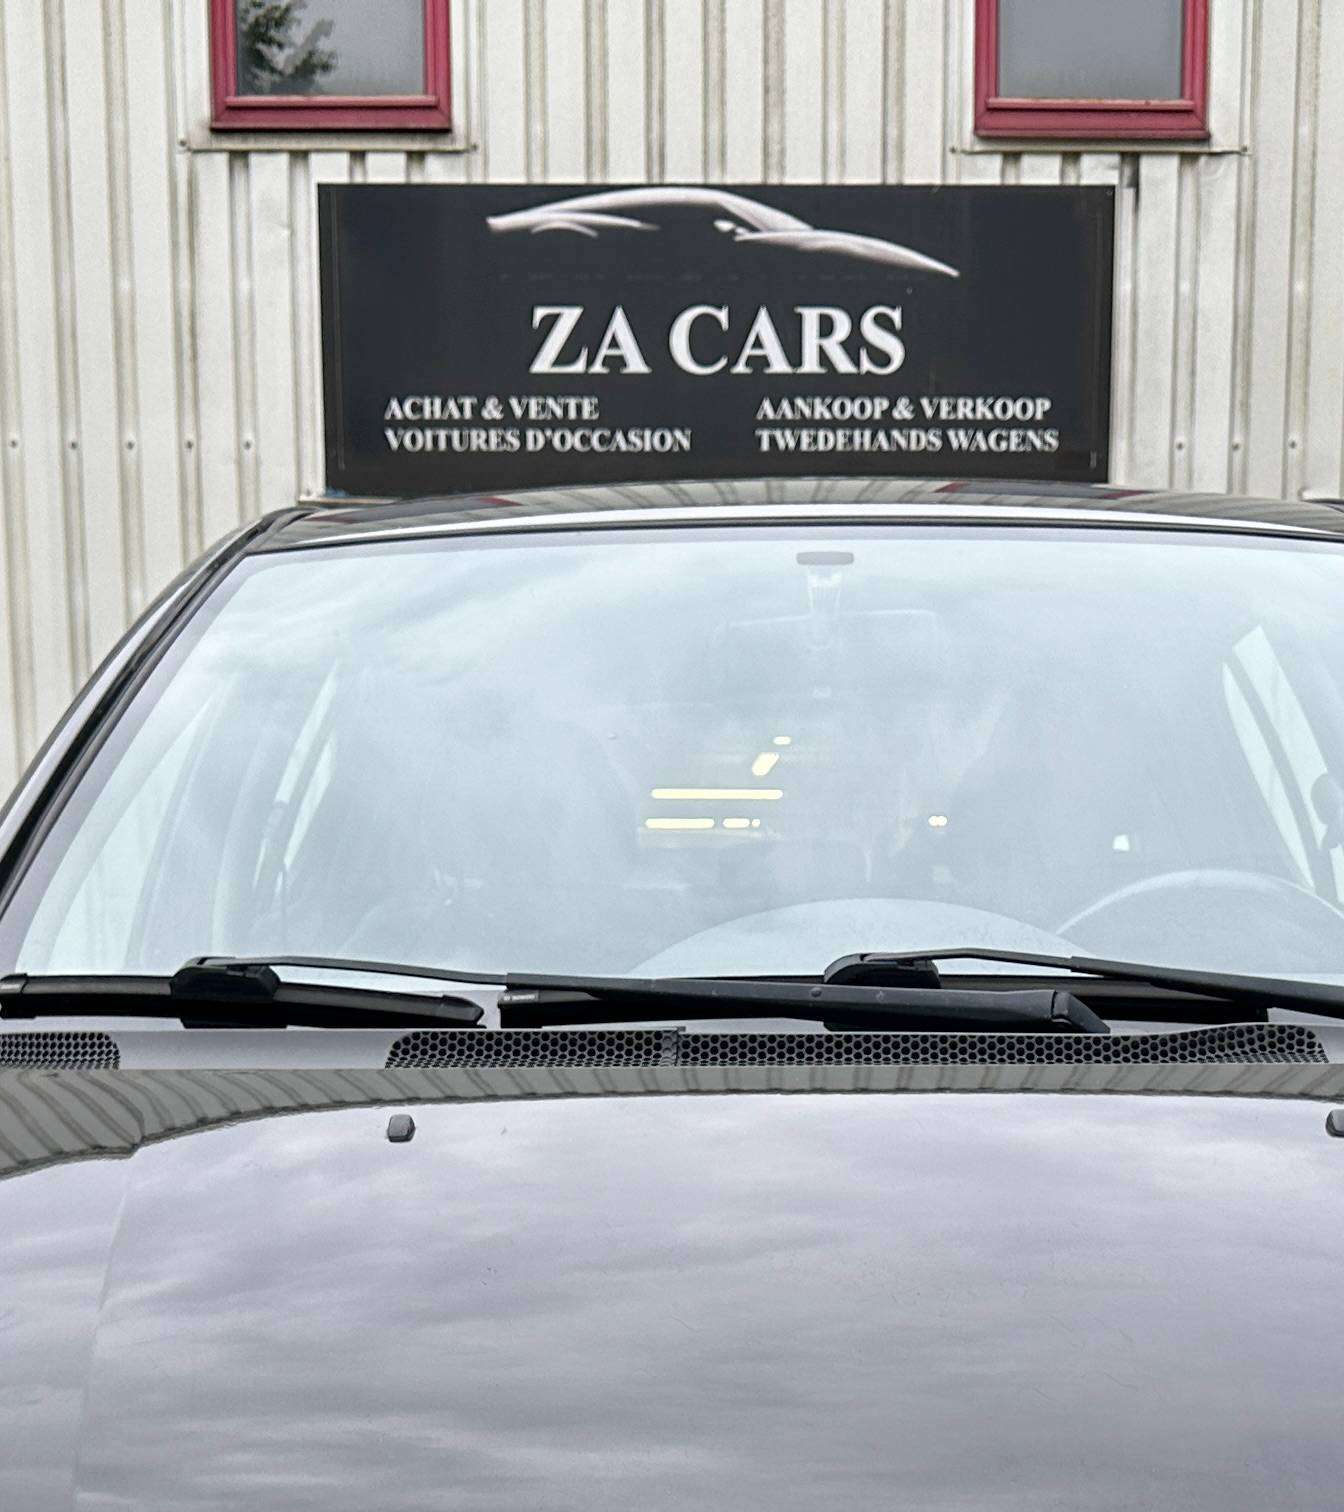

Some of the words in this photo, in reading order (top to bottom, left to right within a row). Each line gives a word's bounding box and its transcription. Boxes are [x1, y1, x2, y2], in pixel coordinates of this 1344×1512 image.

[529, 304, 653, 375] ZA
[668, 304, 907, 376] CARS
[384, 396, 478, 420] ACHAT
[480, 397, 505, 420] &
[509, 396, 600, 420] VENTE
[756, 396, 891, 421] AANKOOP
[891, 397, 916, 421] &
[920, 396, 1052, 421] VERKOOP
[384, 427, 521, 452] VOITURES
[525, 427, 692, 452] D'OCCASION
[755, 428, 943, 452] TWEDEHANDS
[946, 428, 1059, 452] WAGENS
